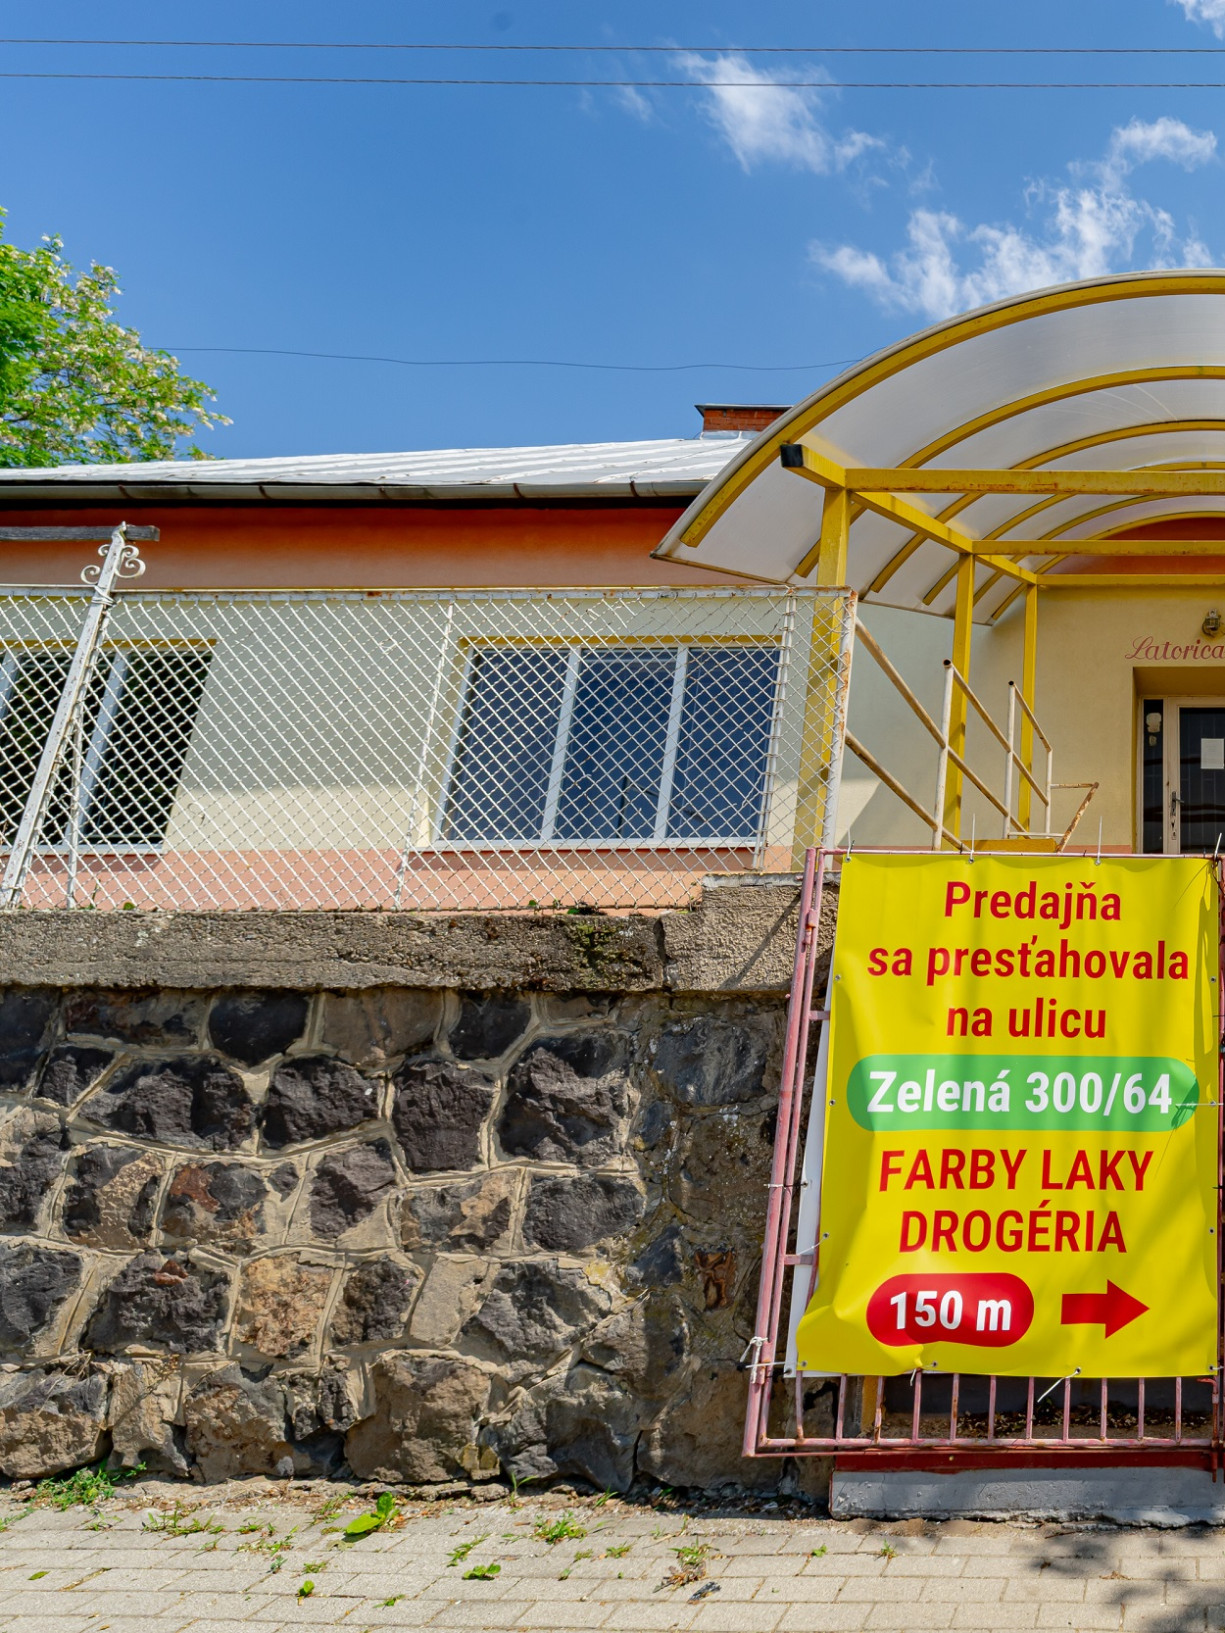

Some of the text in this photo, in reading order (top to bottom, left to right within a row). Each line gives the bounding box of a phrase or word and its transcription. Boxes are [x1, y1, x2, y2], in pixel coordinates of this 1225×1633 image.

[944, 881, 1122, 930] Predajňa
[867, 935, 1189, 986] sa presťahovala
[946, 997, 1107, 1039] na ulicu
[867, 1069, 1173, 1117] Zelená 300/64
[879, 1149, 1154, 1192] FARBY LAKY
[899, 1200, 1127, 1254] DROGÉRIA
[890, 1290, 1012, 1331] 150 m
